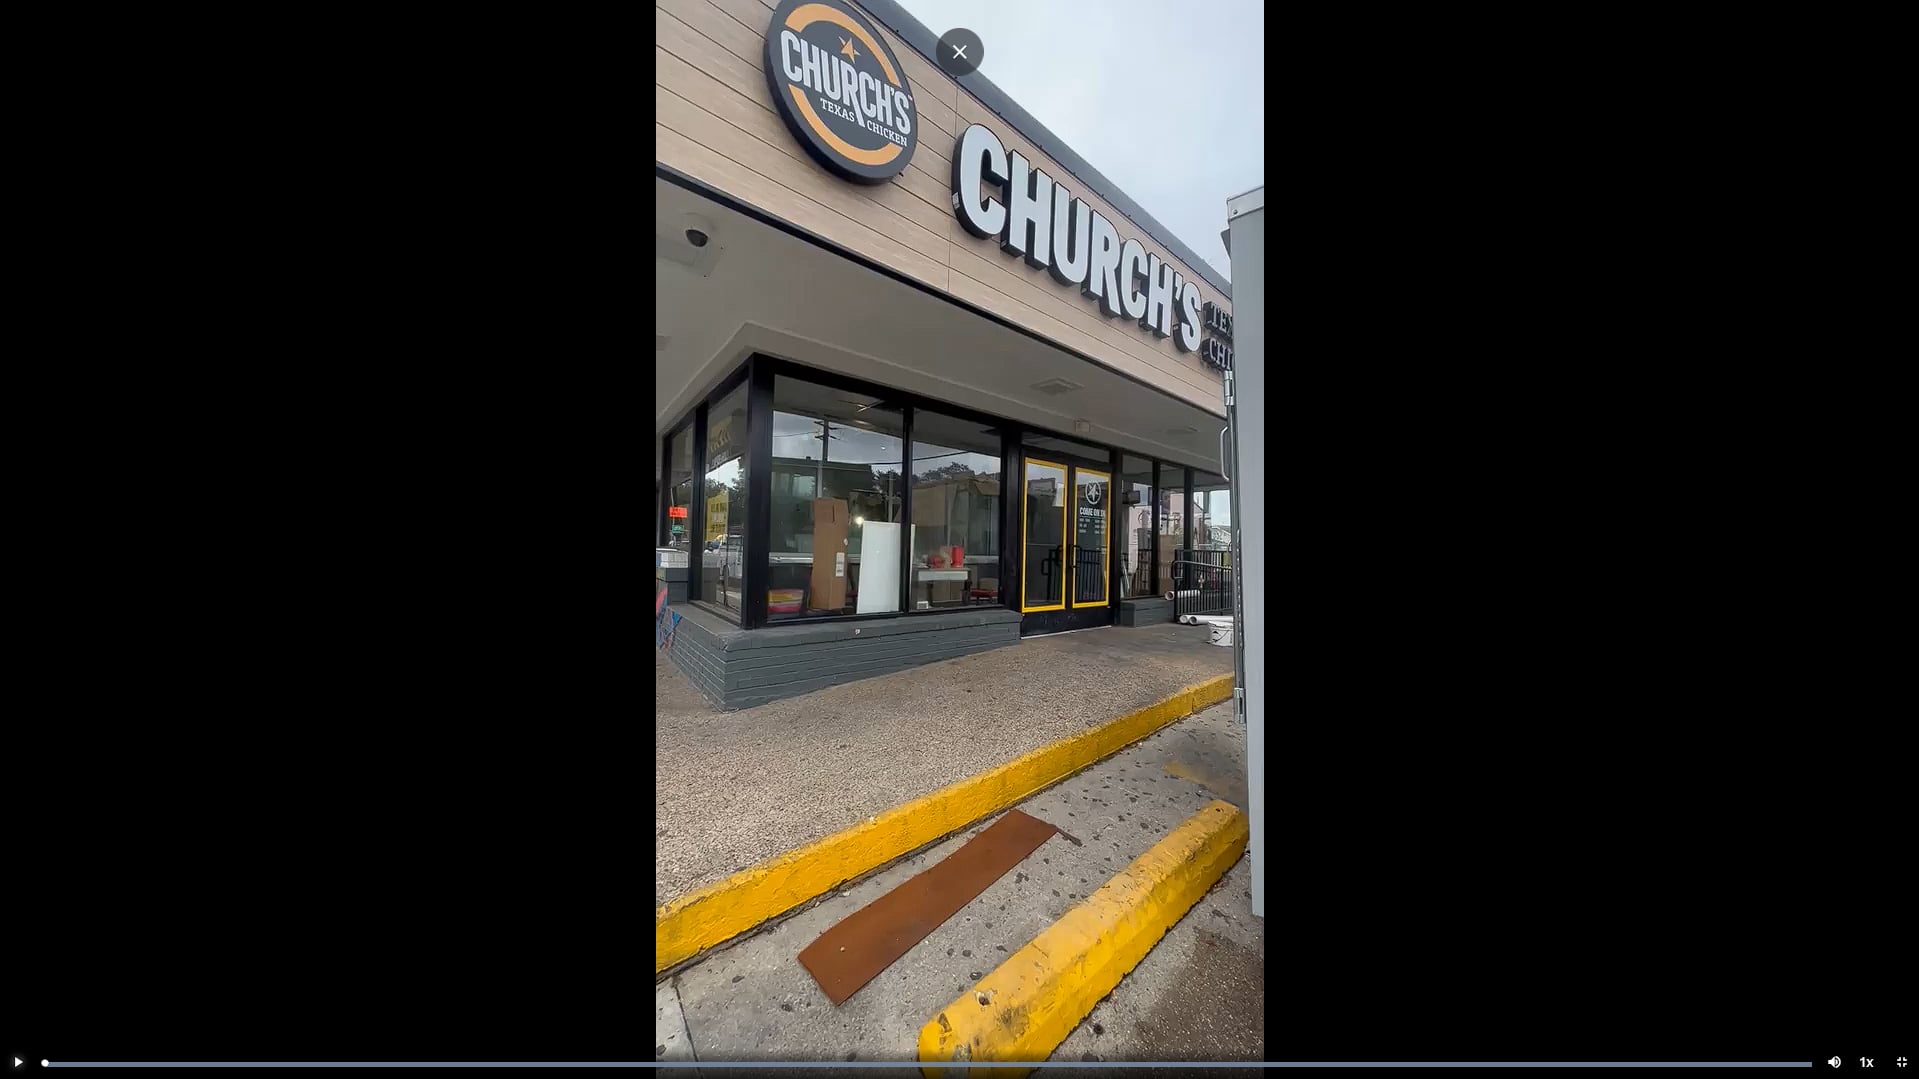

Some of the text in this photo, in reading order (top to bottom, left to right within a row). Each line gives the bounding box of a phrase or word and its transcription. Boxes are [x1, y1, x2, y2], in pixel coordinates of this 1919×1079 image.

[780, 30, 911, 135] CHURCH'S
[820, 98, 908, 147] TEXAS CHICKEN
[956, 123, 1202, 352] CHURCH'S
